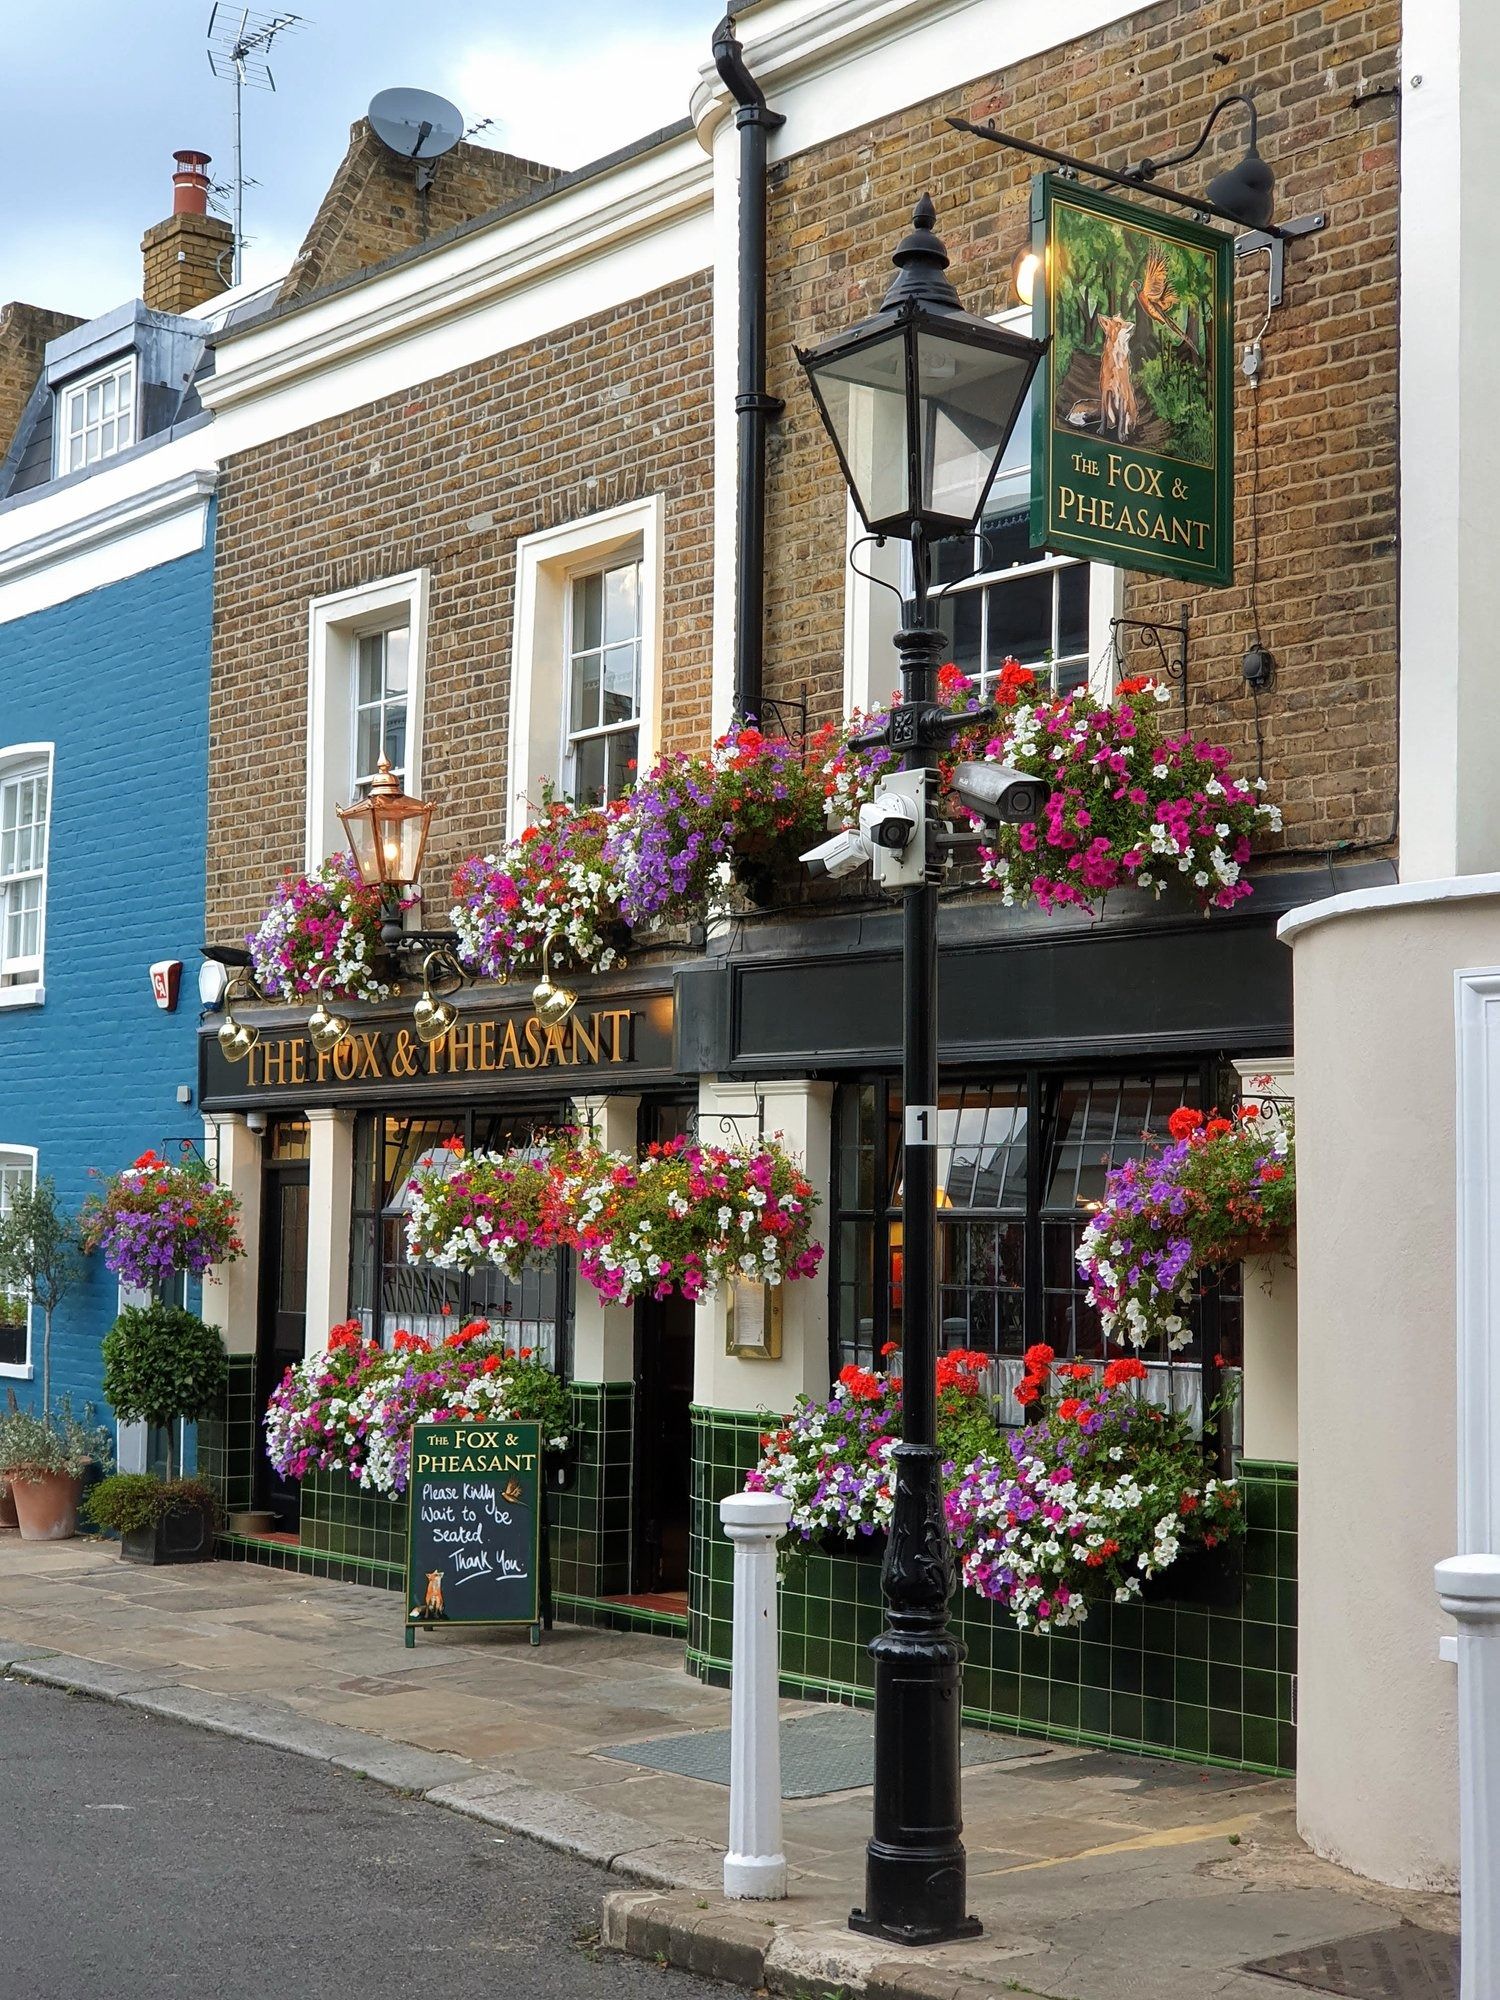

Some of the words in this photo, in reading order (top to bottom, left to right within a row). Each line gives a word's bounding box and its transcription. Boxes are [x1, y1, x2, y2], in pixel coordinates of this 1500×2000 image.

[1107, 454, 1164, 498] FOX
[1171, 477, 1189, 501] &
[1058, 486, 1210, 550] PHEASANT
[246, 1038, 305, 1087] THE
[316, 1031, 381, 1082] FOX
[391, 1029, 418, 1078] &
[427, 1009, 631, 1075] PHEASANT
[916, 1110, 928, 1141] 1
[454, 1430, 499, 1449] FOX
[505, 1433, 519, 1446] &
[417, 1454, 536, 1473] PHEASANT
[422, 1483, 459, 1501] Please
[463, 1484, 496, 1515] Kindly
[421, 1506, 455, 1523] Wait
[462, 1506, 476, 1522] to
[494, 1506, 513, 1525] be
[449, 1548, 493, 1573] Thank
